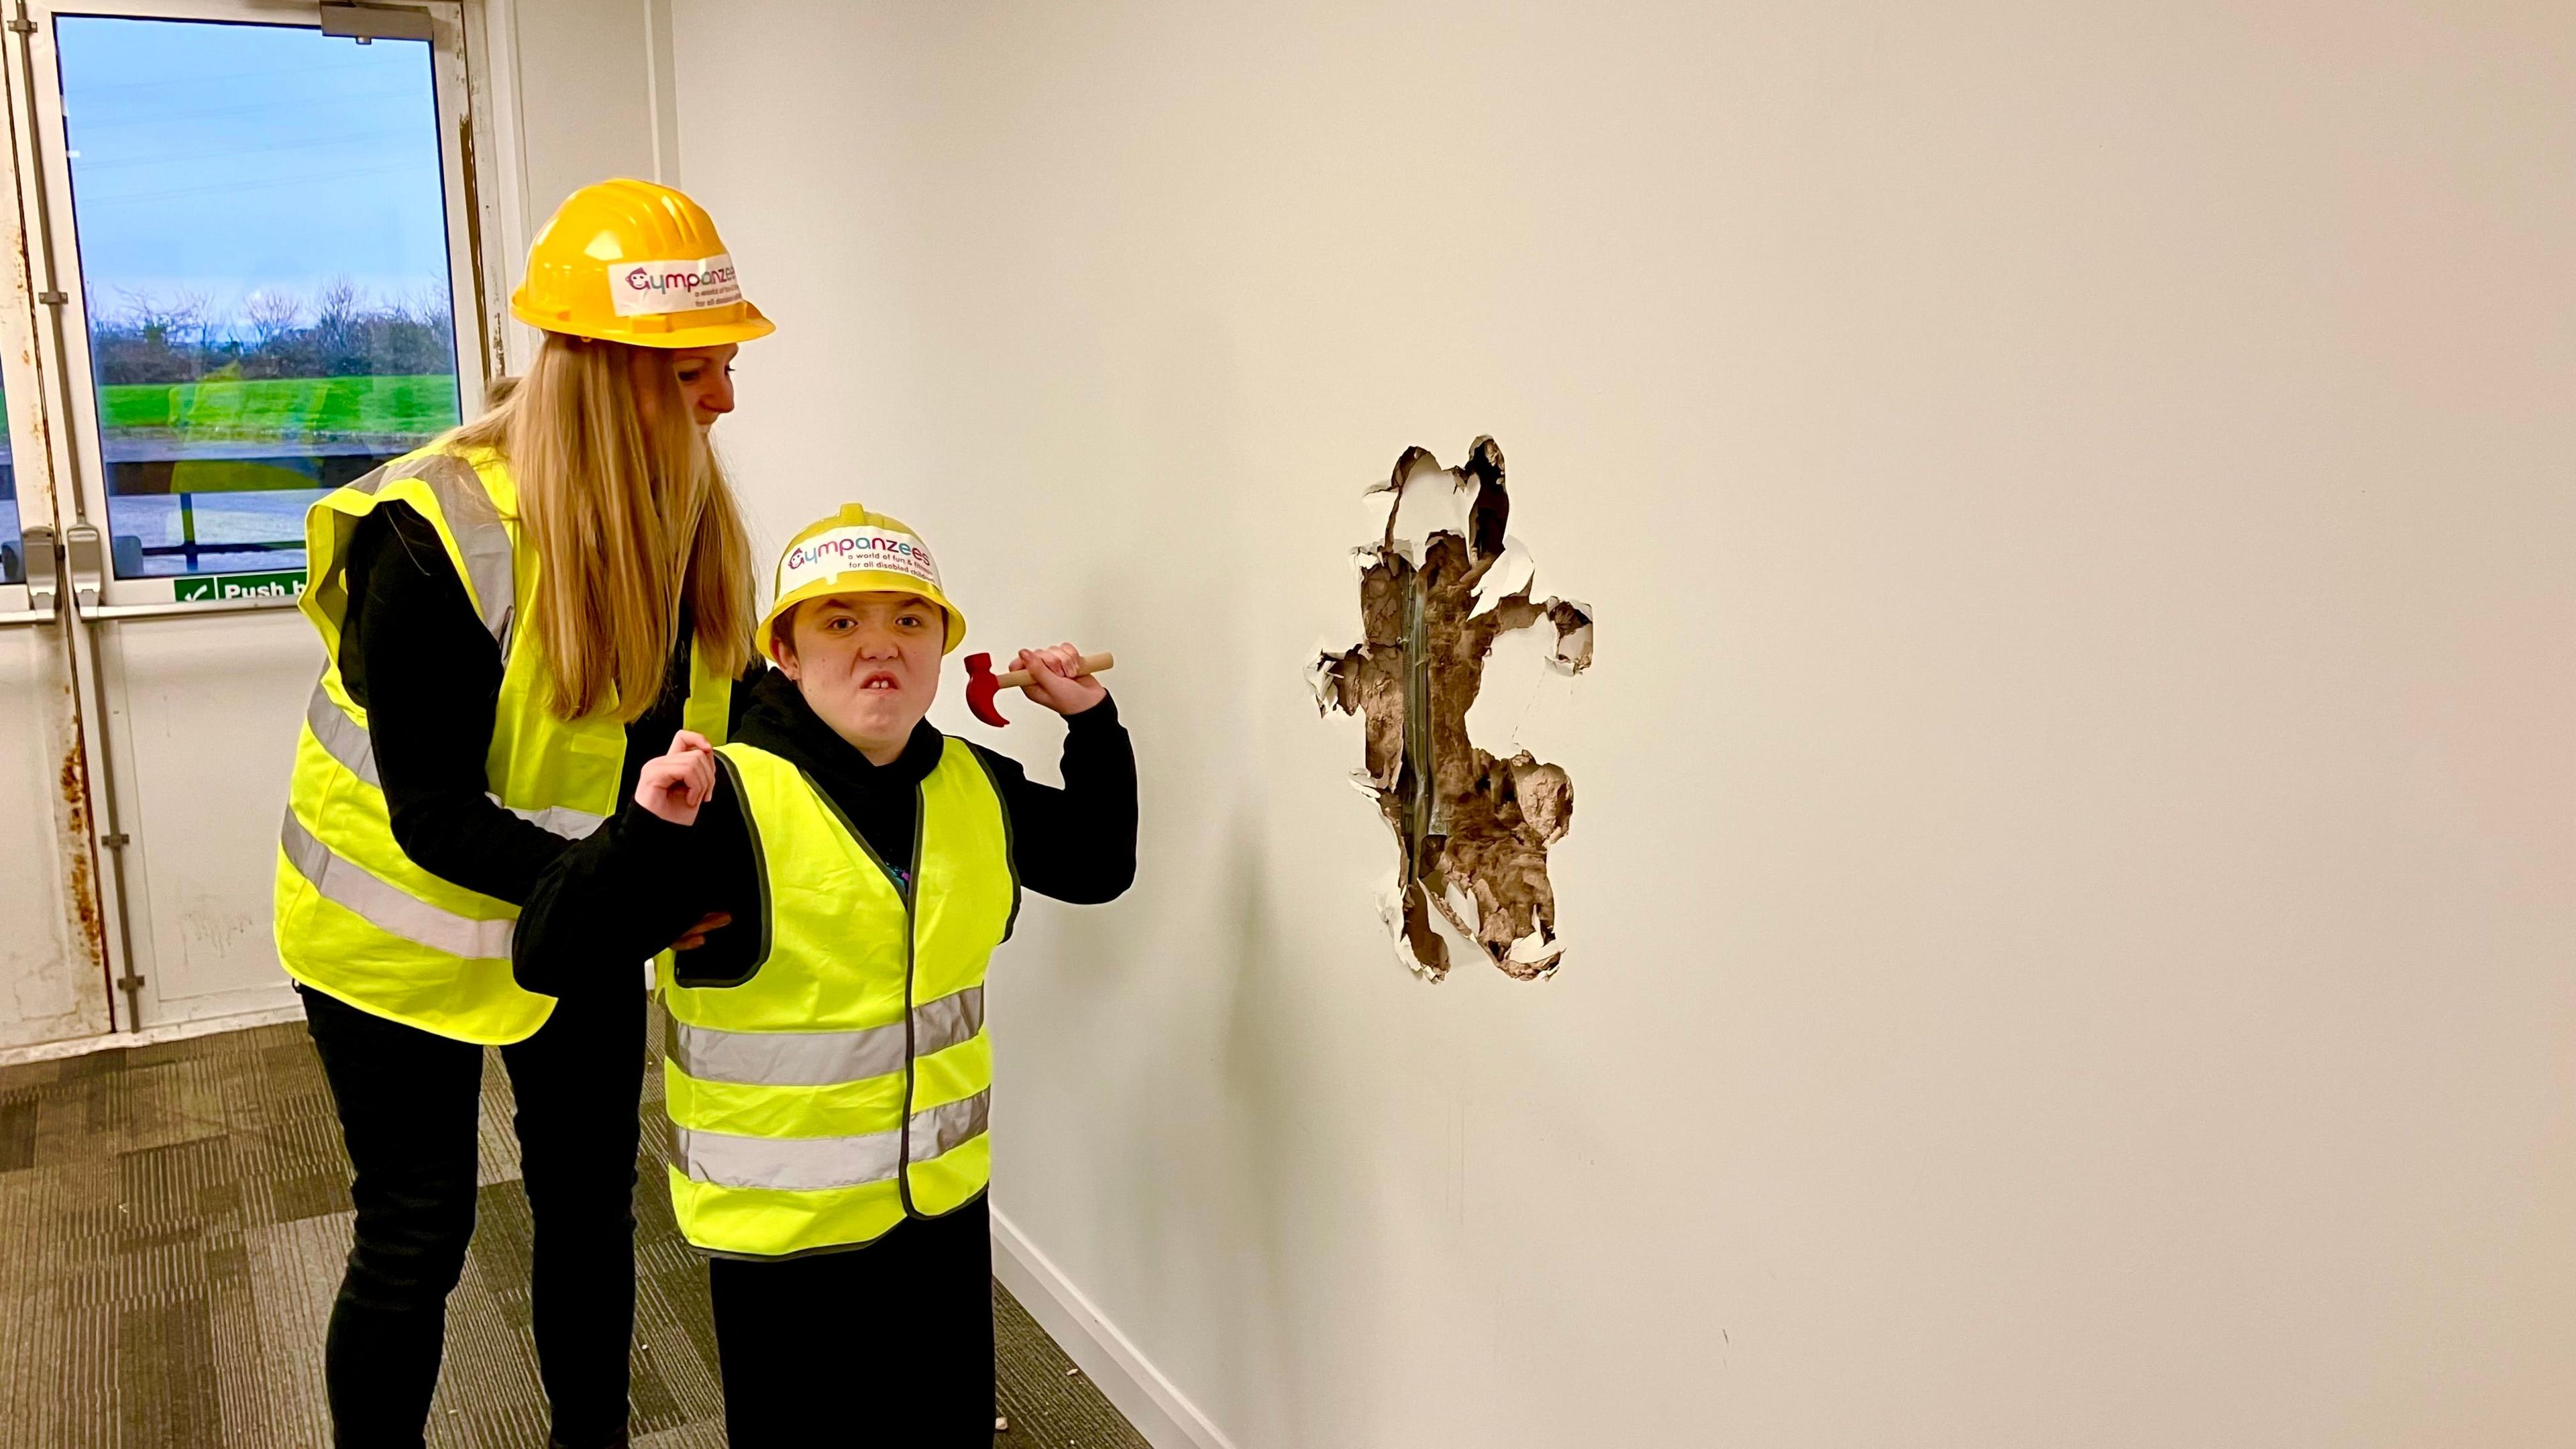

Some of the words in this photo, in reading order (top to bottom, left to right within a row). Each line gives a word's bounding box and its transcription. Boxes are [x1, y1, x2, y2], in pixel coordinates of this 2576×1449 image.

[788, 537, 930, 570] Gympanzees
[893, 555, 906, 564] fun
[876, 562, 909, 573] disabled
[225, 582, 285, 599] Push
